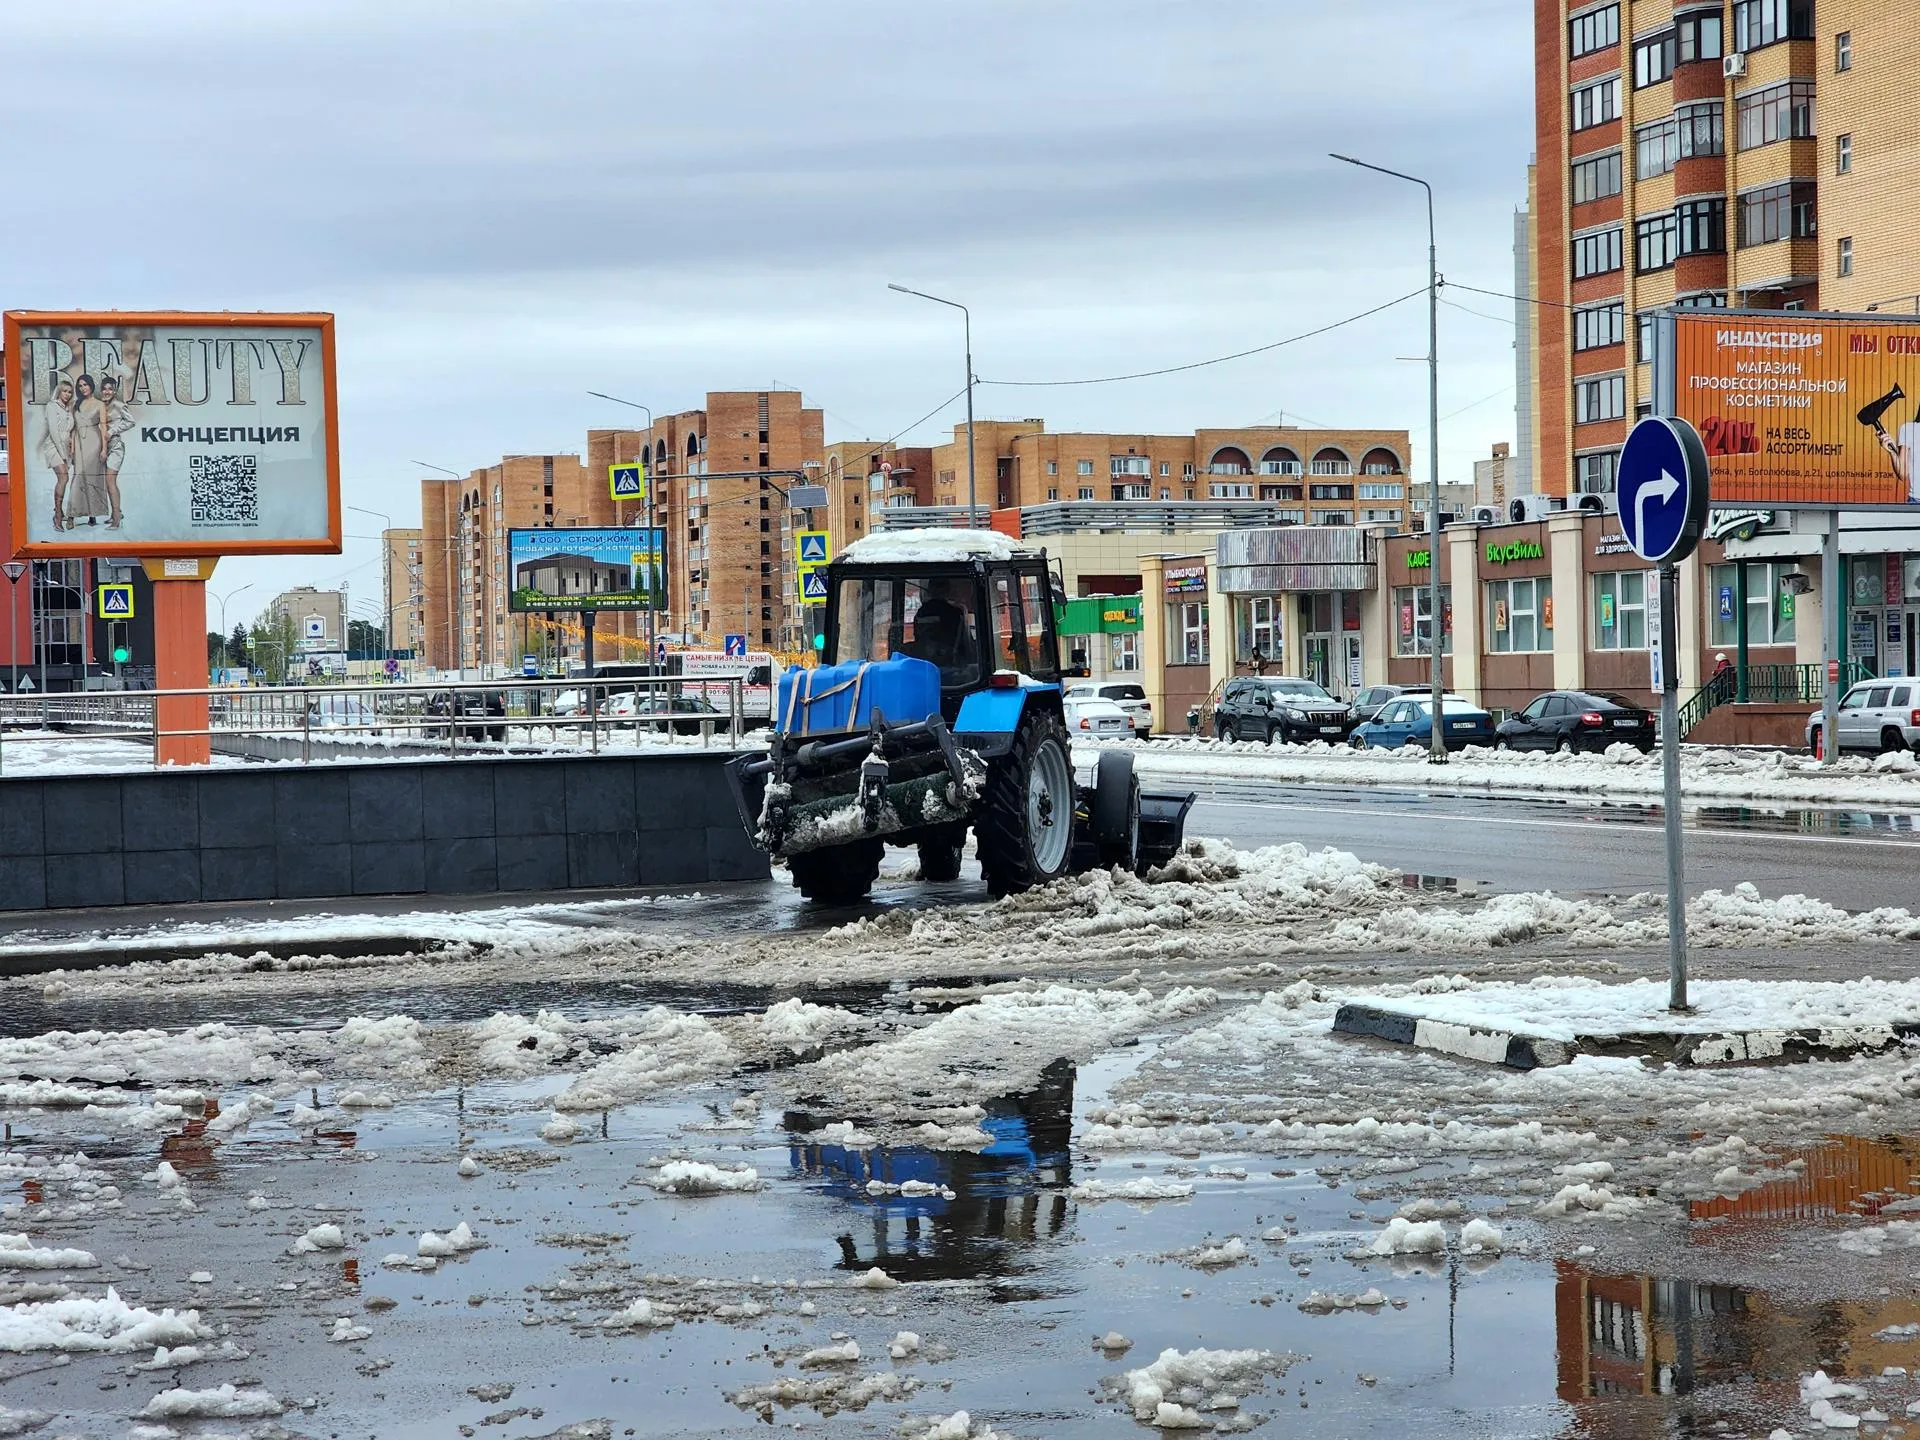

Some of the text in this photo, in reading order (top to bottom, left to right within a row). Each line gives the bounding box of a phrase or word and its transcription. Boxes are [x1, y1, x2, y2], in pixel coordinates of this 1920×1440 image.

[1717, 330, 1823, 348] ИНДУСТРИЯ
[1850, 334, 1920, 356] МЫ ОТК
[26, 338, 313, 406] BEAUTY
[1737, 361, 1802, 375] МАГАЗИН
[1690, 376, 1847, 394] ПРОФЕССИОНАЛЬНОЙ
[1727, 394, 1812, 408] КОСМЕТИКИ
[141, 426, 301, 446] КОНЦЕПЦИЯ
[1766, 427, 1811, 441] НА ВЕСЬ
[1766, 442, 1844, 457] АССОРТИМЕНТ
[1710, 466, 1732, 478] убна,
[1407, 551, 1431, 568] КАФЕ
[745, 655, 767, 663] ЦЕНЫ
